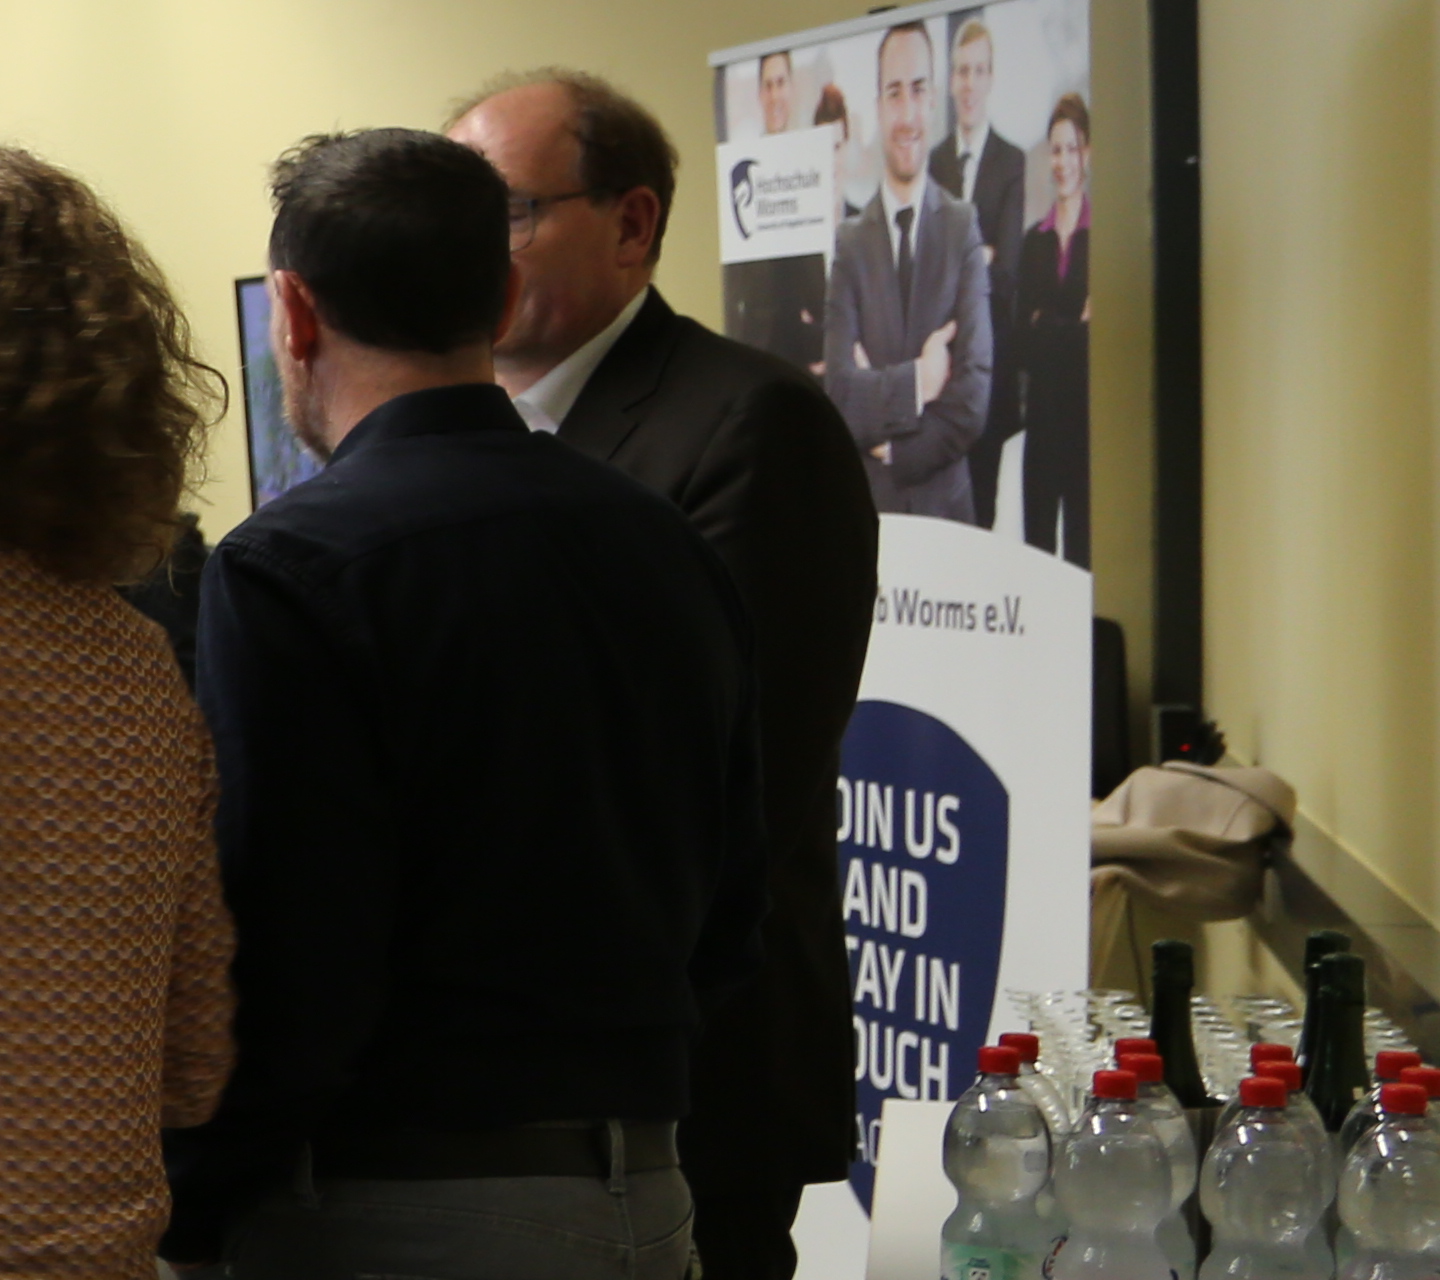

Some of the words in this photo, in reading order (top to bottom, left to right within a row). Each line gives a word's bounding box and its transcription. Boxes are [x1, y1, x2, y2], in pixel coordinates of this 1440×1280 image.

[893, 587, 976, 631] Worms
[984, 596, 1024, 636] e.V.
[836, 775, 893, 852] OIN
[904, 788, 960, 865] US
[842, 857, 928, 939] AND
[915, 953, 960, 1032] IN
[852, 1015, 949, 1103] OUCH
